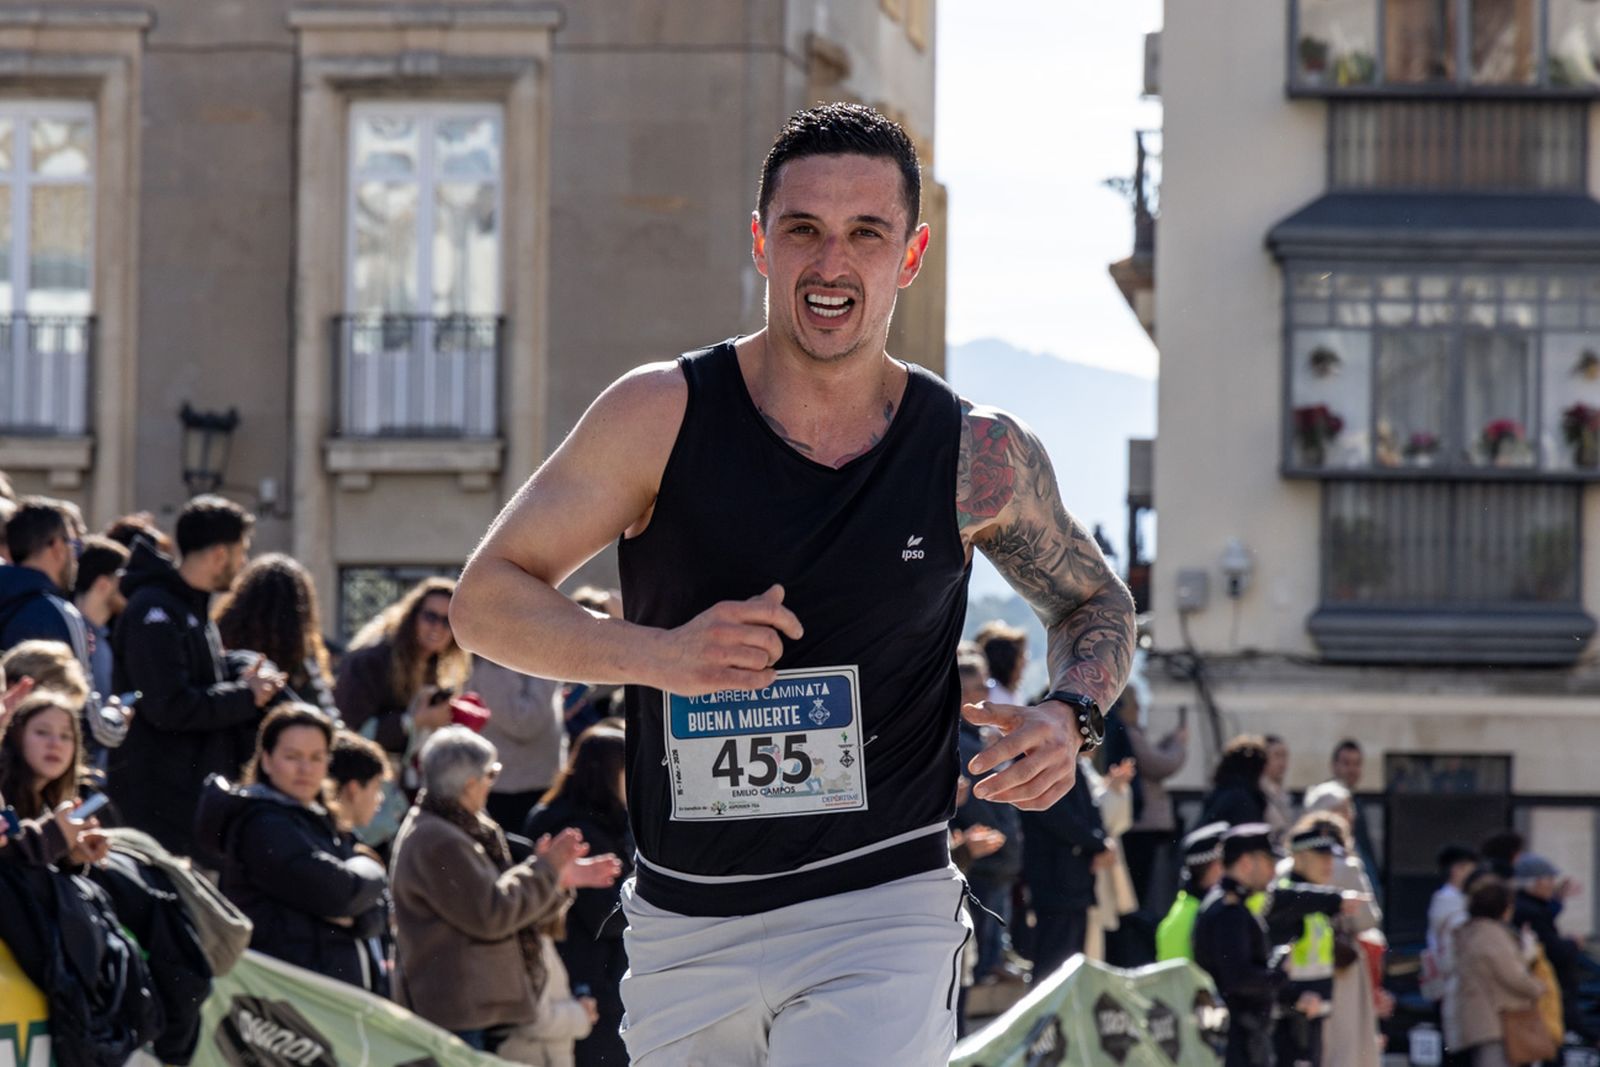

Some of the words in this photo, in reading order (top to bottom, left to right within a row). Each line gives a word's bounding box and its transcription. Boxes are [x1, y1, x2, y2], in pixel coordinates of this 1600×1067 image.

[701, 689, 759, 704] CARRERA
[761, 682, 830, 700] CAMINATA
[688, 710, 734, 732] BUENA
[738, 705, 800, 729] MUERTE
[711, 733, 812, 788] 455
[731, 788, 759, 798] EMILIO
[760, 786, 796, 797] CAMPOS
